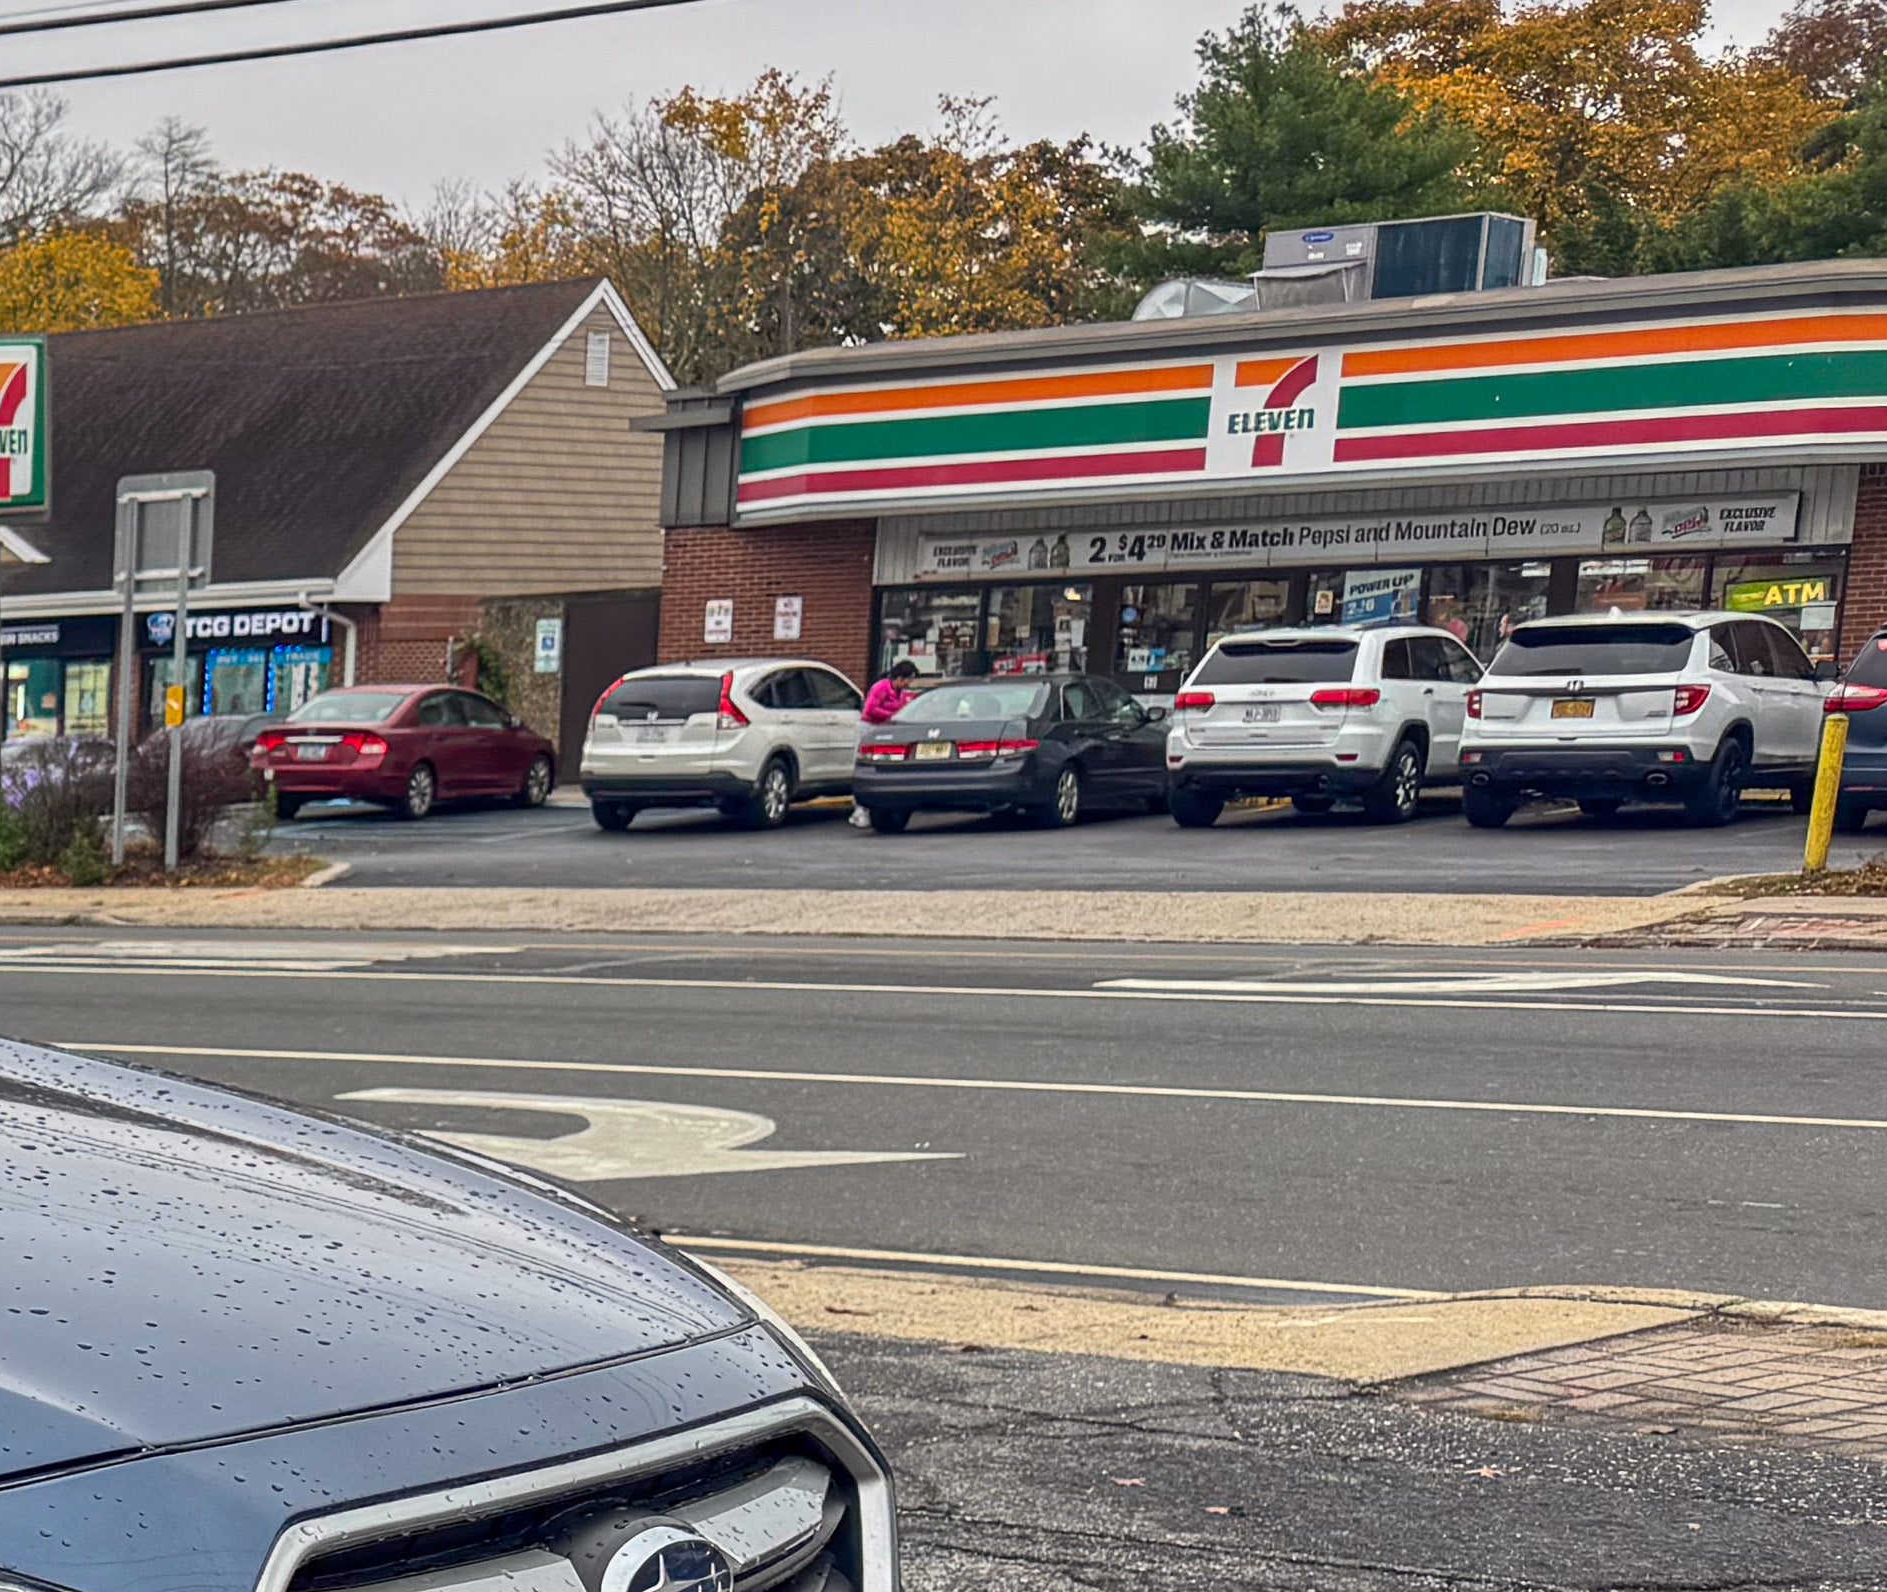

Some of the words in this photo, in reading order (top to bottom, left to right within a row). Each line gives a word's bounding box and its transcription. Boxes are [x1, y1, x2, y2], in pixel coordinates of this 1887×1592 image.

[1724, 520, 1767, 533] FLAVOR
[1088, 536, 1107, 563] 2
[1171, 532, 1207, 551] Mix
[1211, 531, 1225, 549] &
[1228, 526, 1294, 549] Match
[1299, 526, 1351, 549] Pepsi
[1354, 521, 1390, 544] and
[1394, 518, 1488, 542] Mountain
[1493, 516, 1536, 537] Dew
[1349, 578, 1390, 596] POWER
[1392, 574, 1415, 588] UP
[1764, 582, 1825, 606] ATM
[184, 614, 231, 638] TCG
[233, 611, 316, 637] DEPOT
